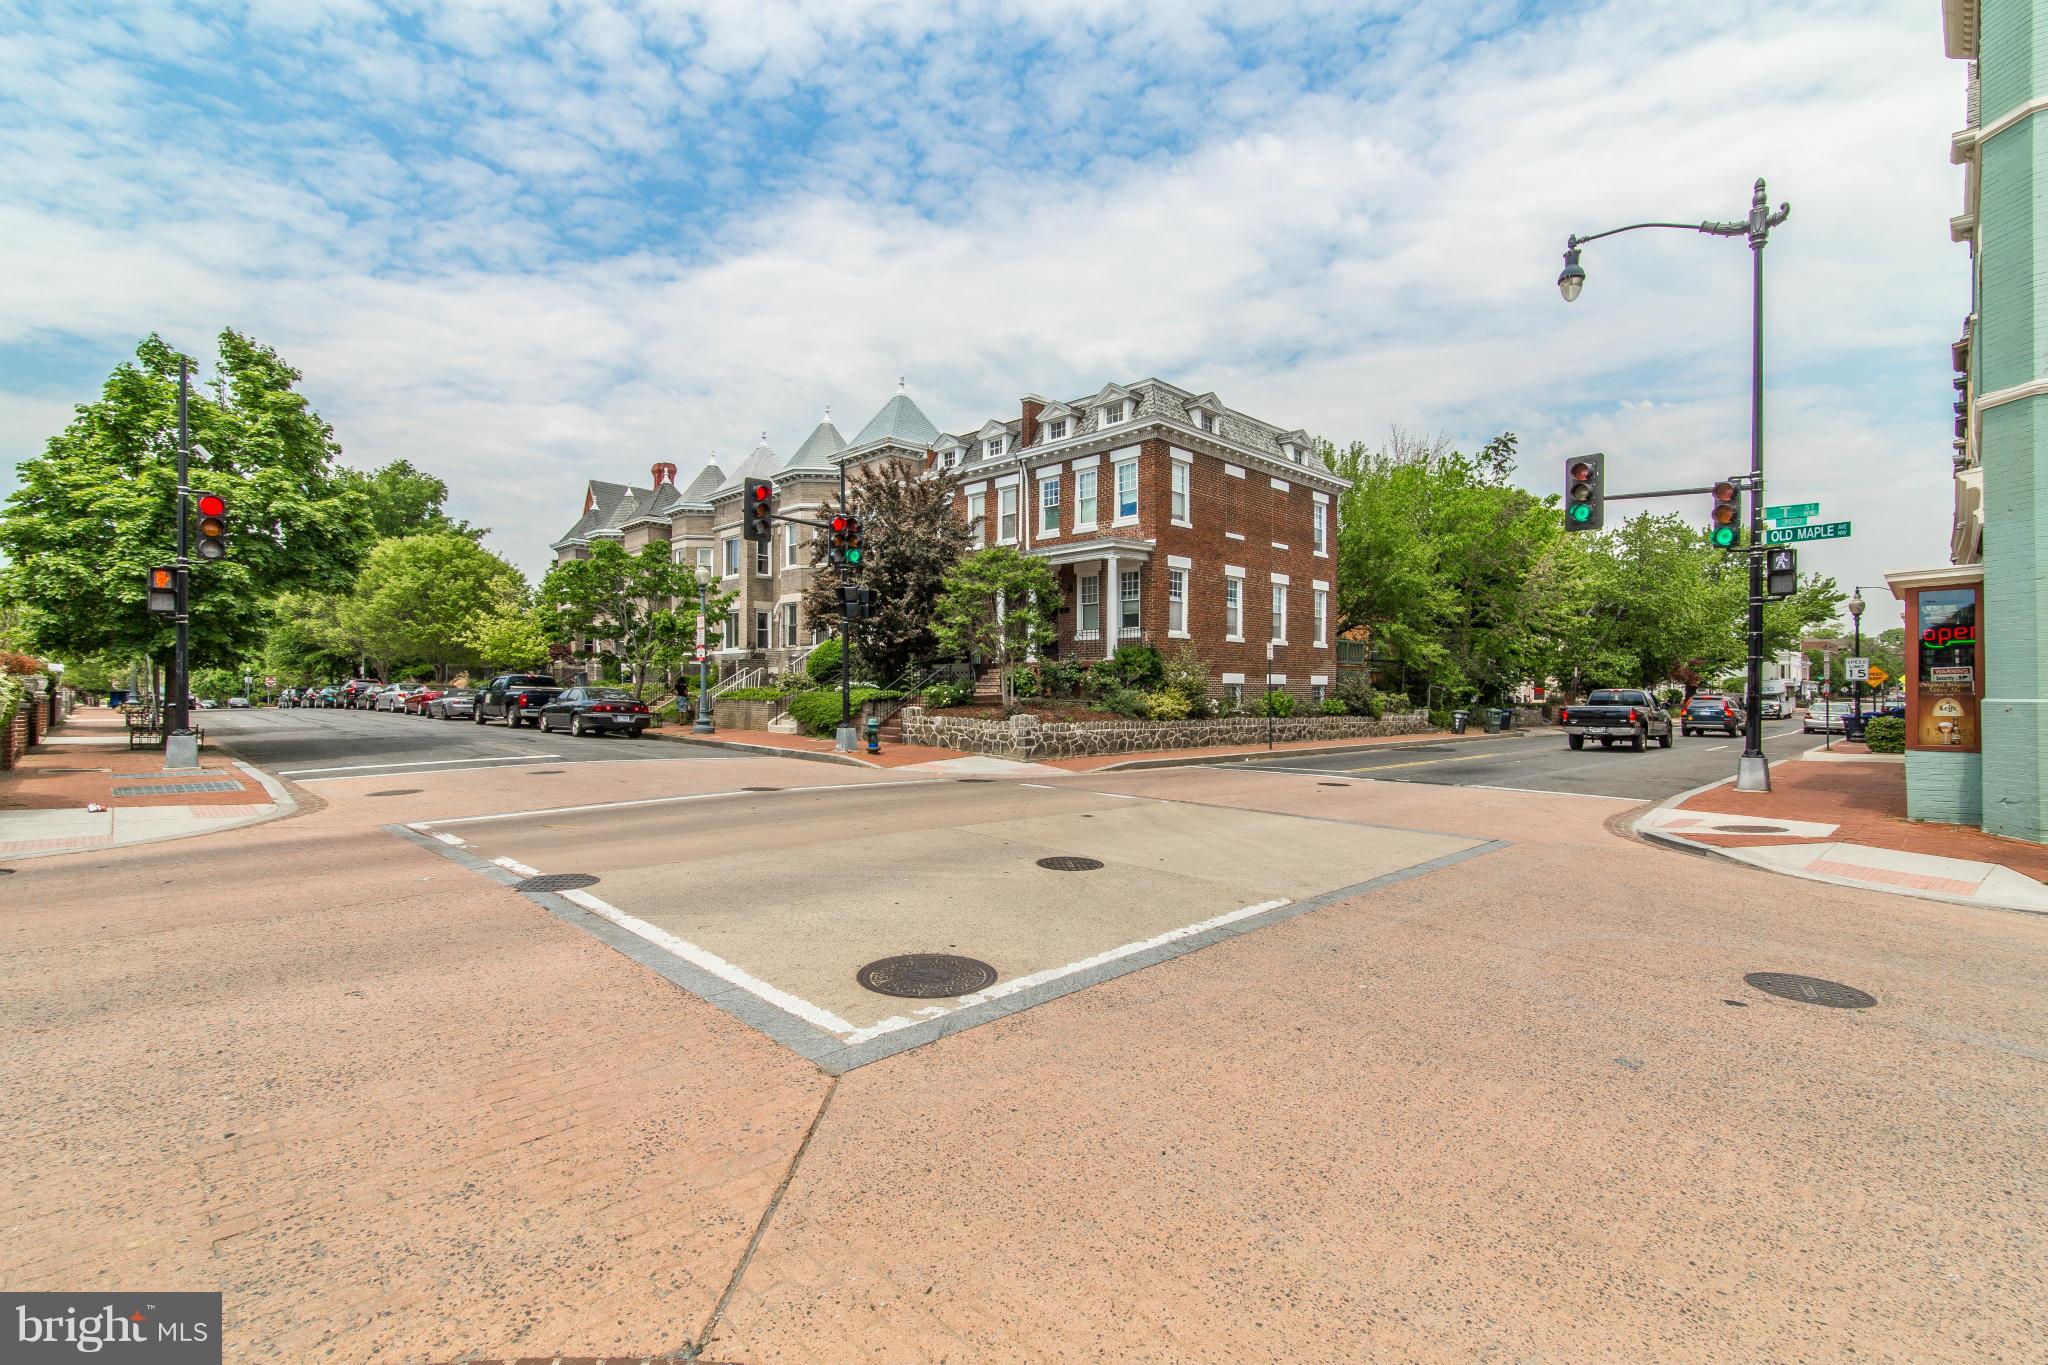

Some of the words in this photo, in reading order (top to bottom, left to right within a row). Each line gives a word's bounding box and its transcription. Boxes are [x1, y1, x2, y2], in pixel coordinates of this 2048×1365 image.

[1780, 507, 1792, 518] T
[1771, 529, 1793, 542] OLD
[1797, 525, 1835, 540] MAPLE
[1849, 669, 1866, 678] 15
